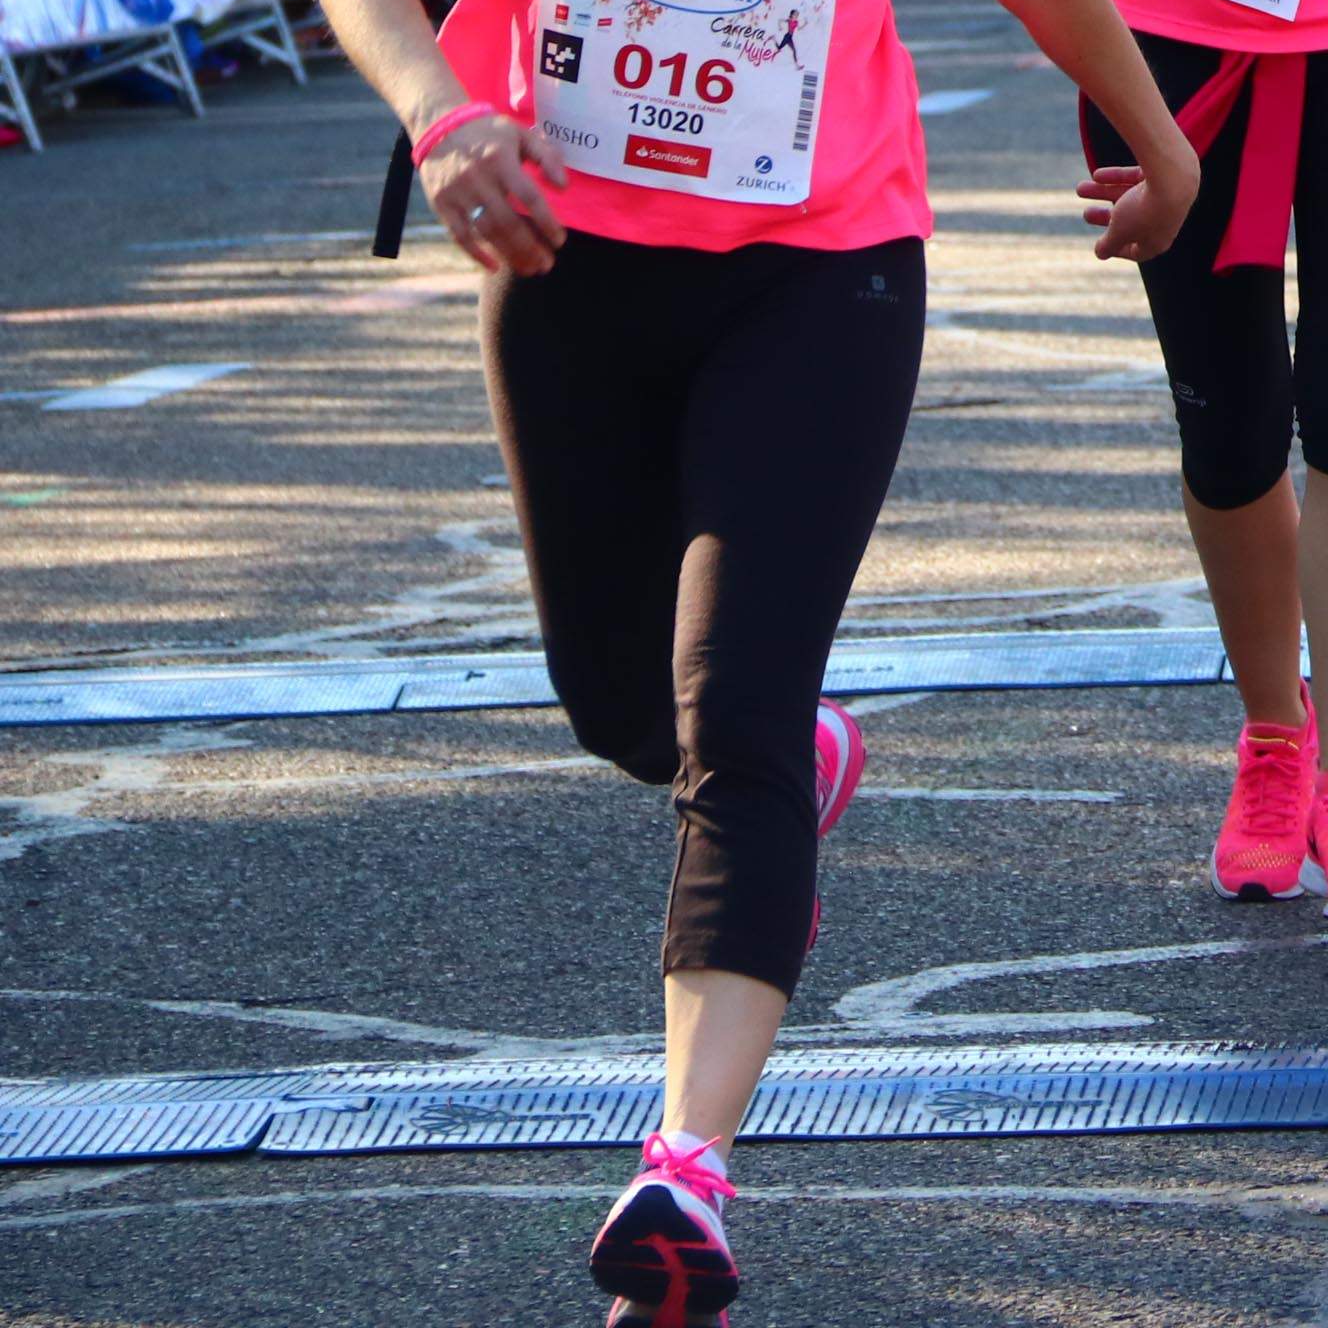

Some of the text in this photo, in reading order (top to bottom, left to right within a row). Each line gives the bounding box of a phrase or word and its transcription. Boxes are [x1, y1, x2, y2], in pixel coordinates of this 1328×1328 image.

[710, 16, 766, 41] Carrera
[613, 44, 736, 104] 016
[628, 103, 704, 135] 13020
[543, 120, 599, 150] OYSHO
[648, 149, 700, 168] Santander
[736, 175, 787, 192] ZURICH
